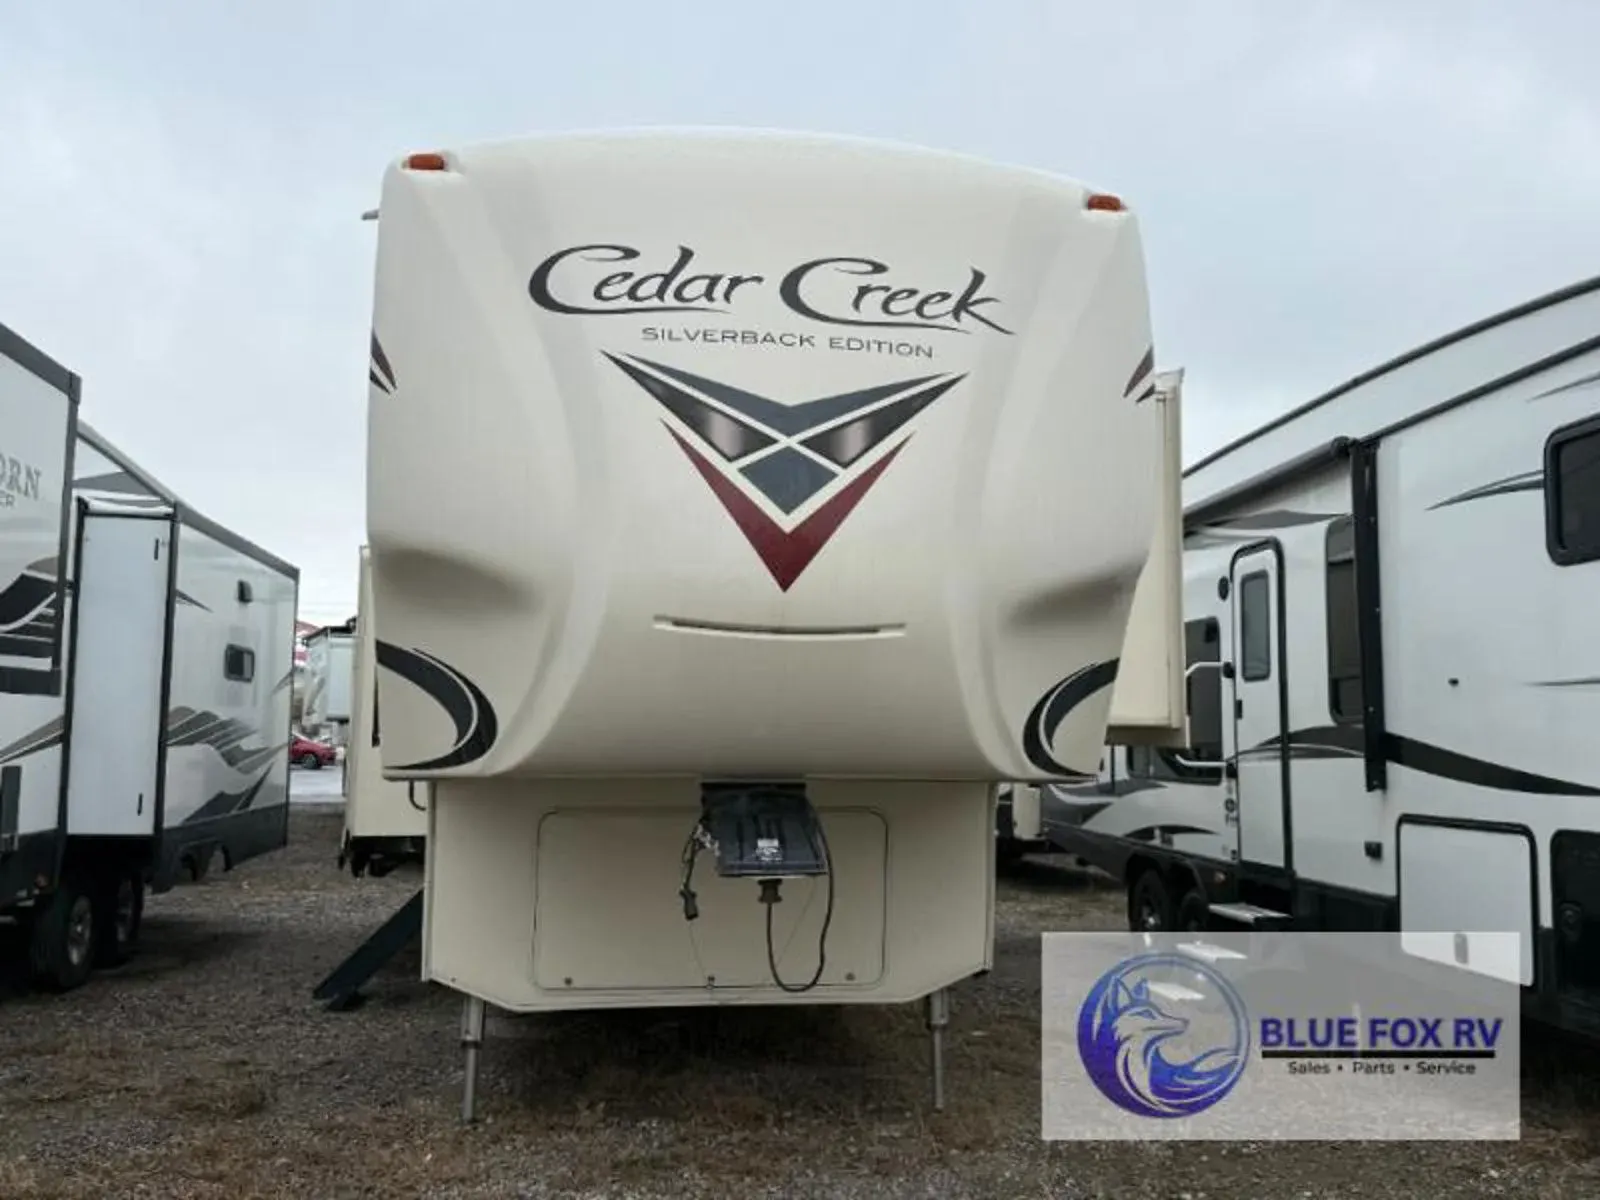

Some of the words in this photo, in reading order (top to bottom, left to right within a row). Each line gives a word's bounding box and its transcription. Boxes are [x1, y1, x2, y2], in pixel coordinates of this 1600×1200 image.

[528, 244, 764, 315] Cedar
[779, 256, 1016, 335] Creek
[641, 326, 816, 348] SILVERBACK
[828, 336, 934, 359] EDITION
